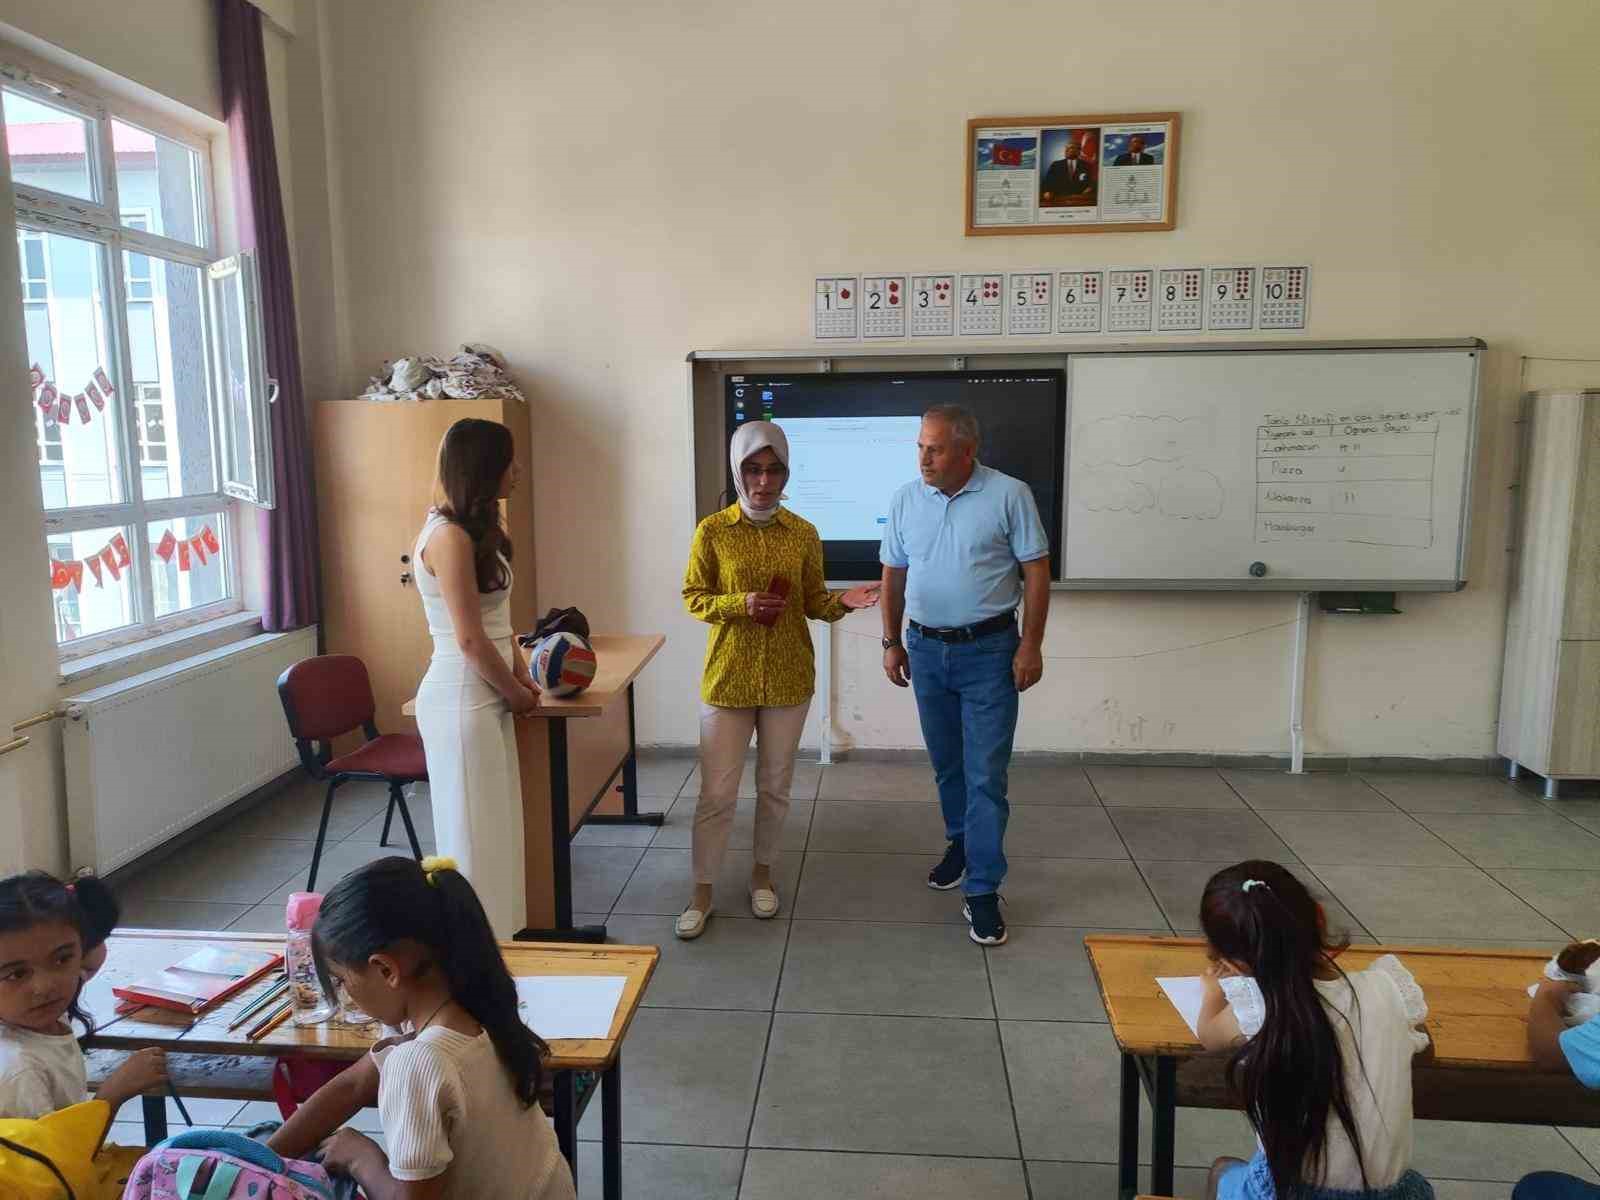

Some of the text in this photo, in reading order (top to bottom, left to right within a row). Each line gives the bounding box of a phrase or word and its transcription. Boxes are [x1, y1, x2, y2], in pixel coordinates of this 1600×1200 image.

[918, 290, 929, 308] 3
[965, 289, 978, 306] 4
[1016, 291, 1027, 306] 5
[1065, 288, 1076, 304] 6
[1115, 287, 1127, 303] 7
[1166, 285, 1177, 301] 8
[1216, 284, 1227, 300] 9
[1264, 283, 1283, 300] 10
[824, 293, 831, 310] 1
[869, 292, 881, 310] 2
[1272, 460, 1304, 476] Pizza
